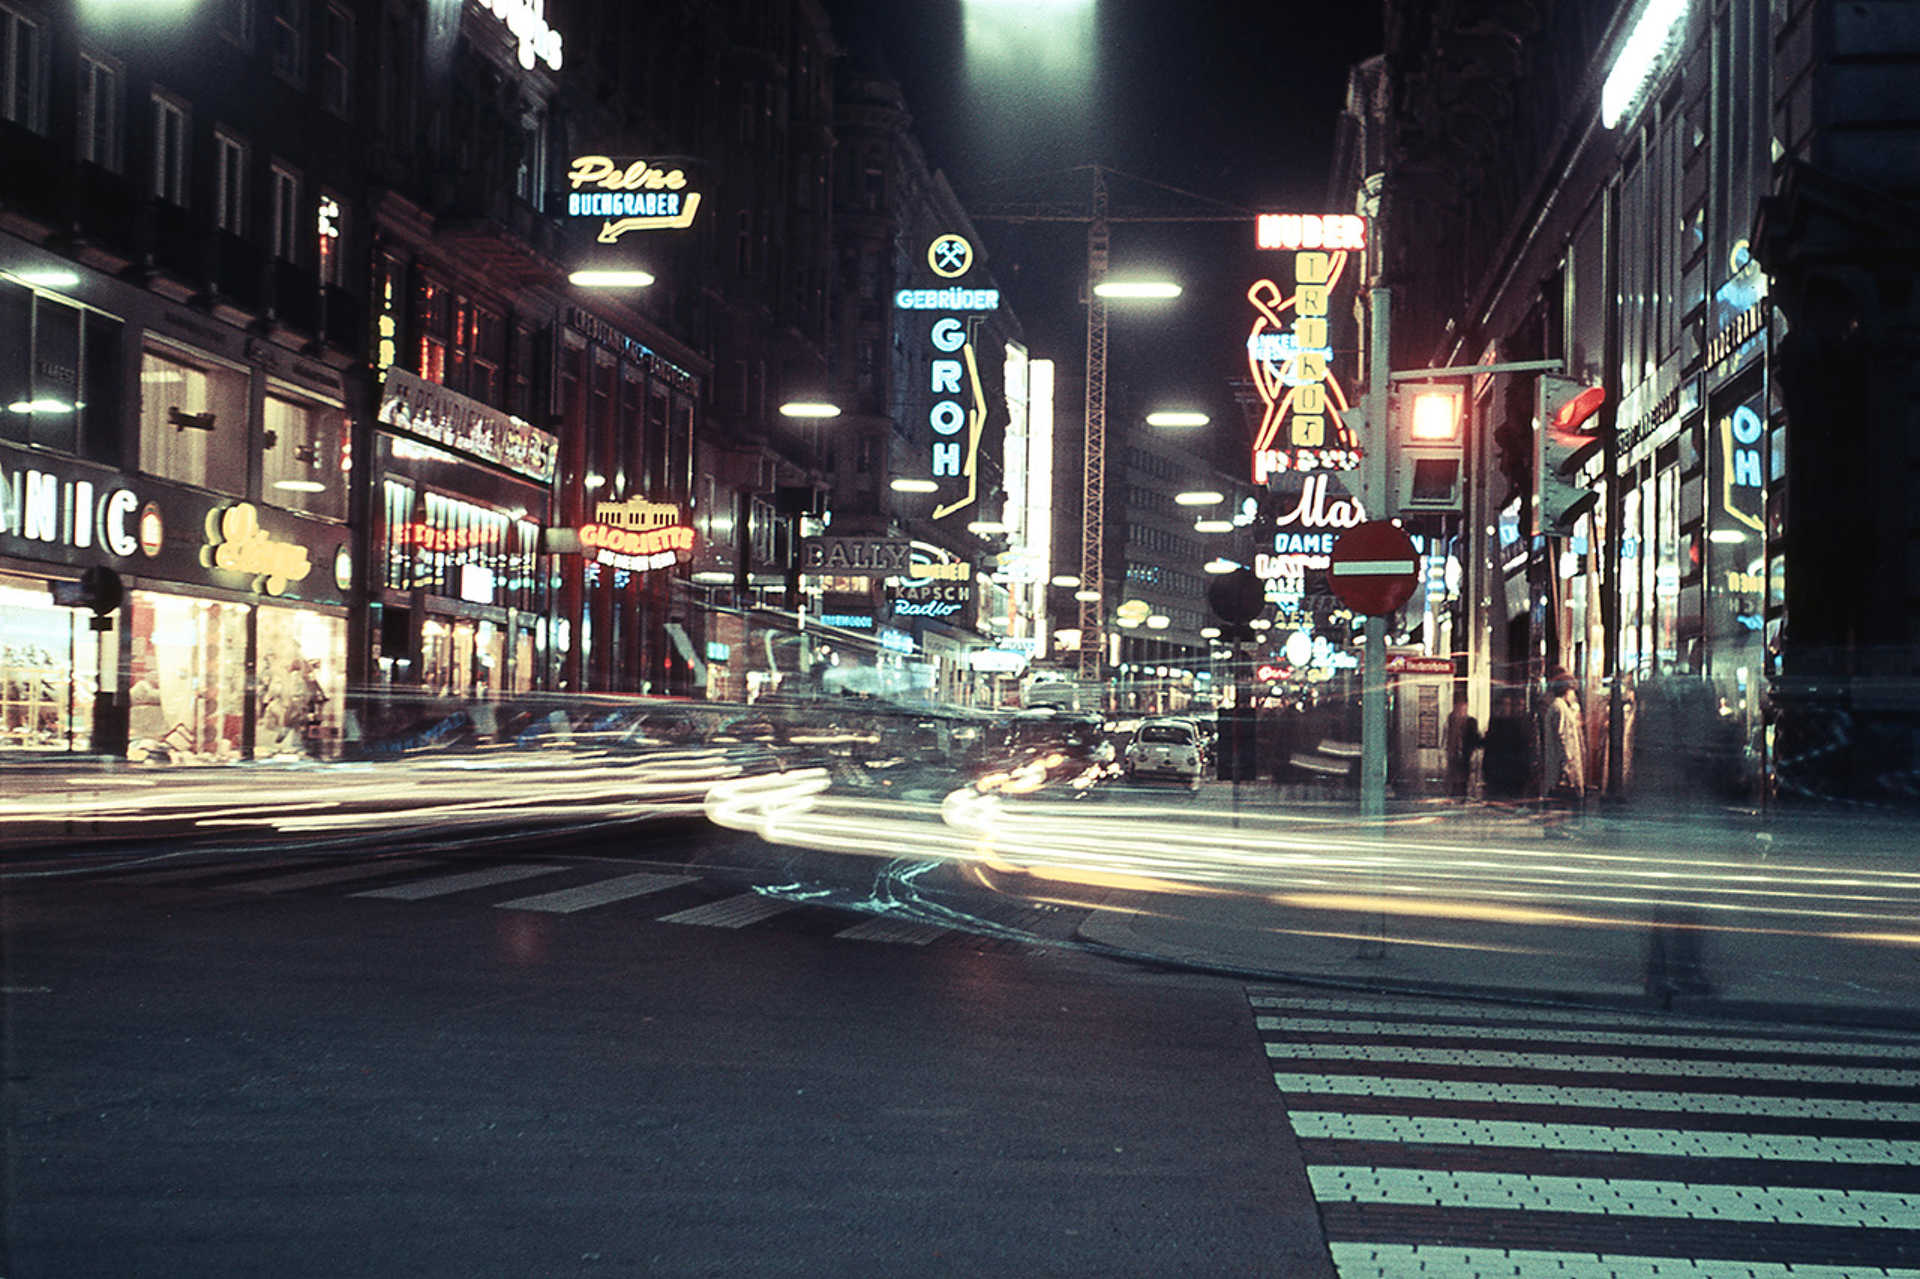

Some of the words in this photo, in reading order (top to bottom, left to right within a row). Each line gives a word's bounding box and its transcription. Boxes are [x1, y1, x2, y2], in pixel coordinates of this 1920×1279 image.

[568, 192, 680, 216] BUCHGRABER
[896, 287, 1000, 310] GEBRÜDER
[930, 318, 967, 477] GROH
[578, 523, 696, 555] GLORIETTE
[805, 541, 910, 570] BALLY
[895, 586, 970, 601] KAPSCH
